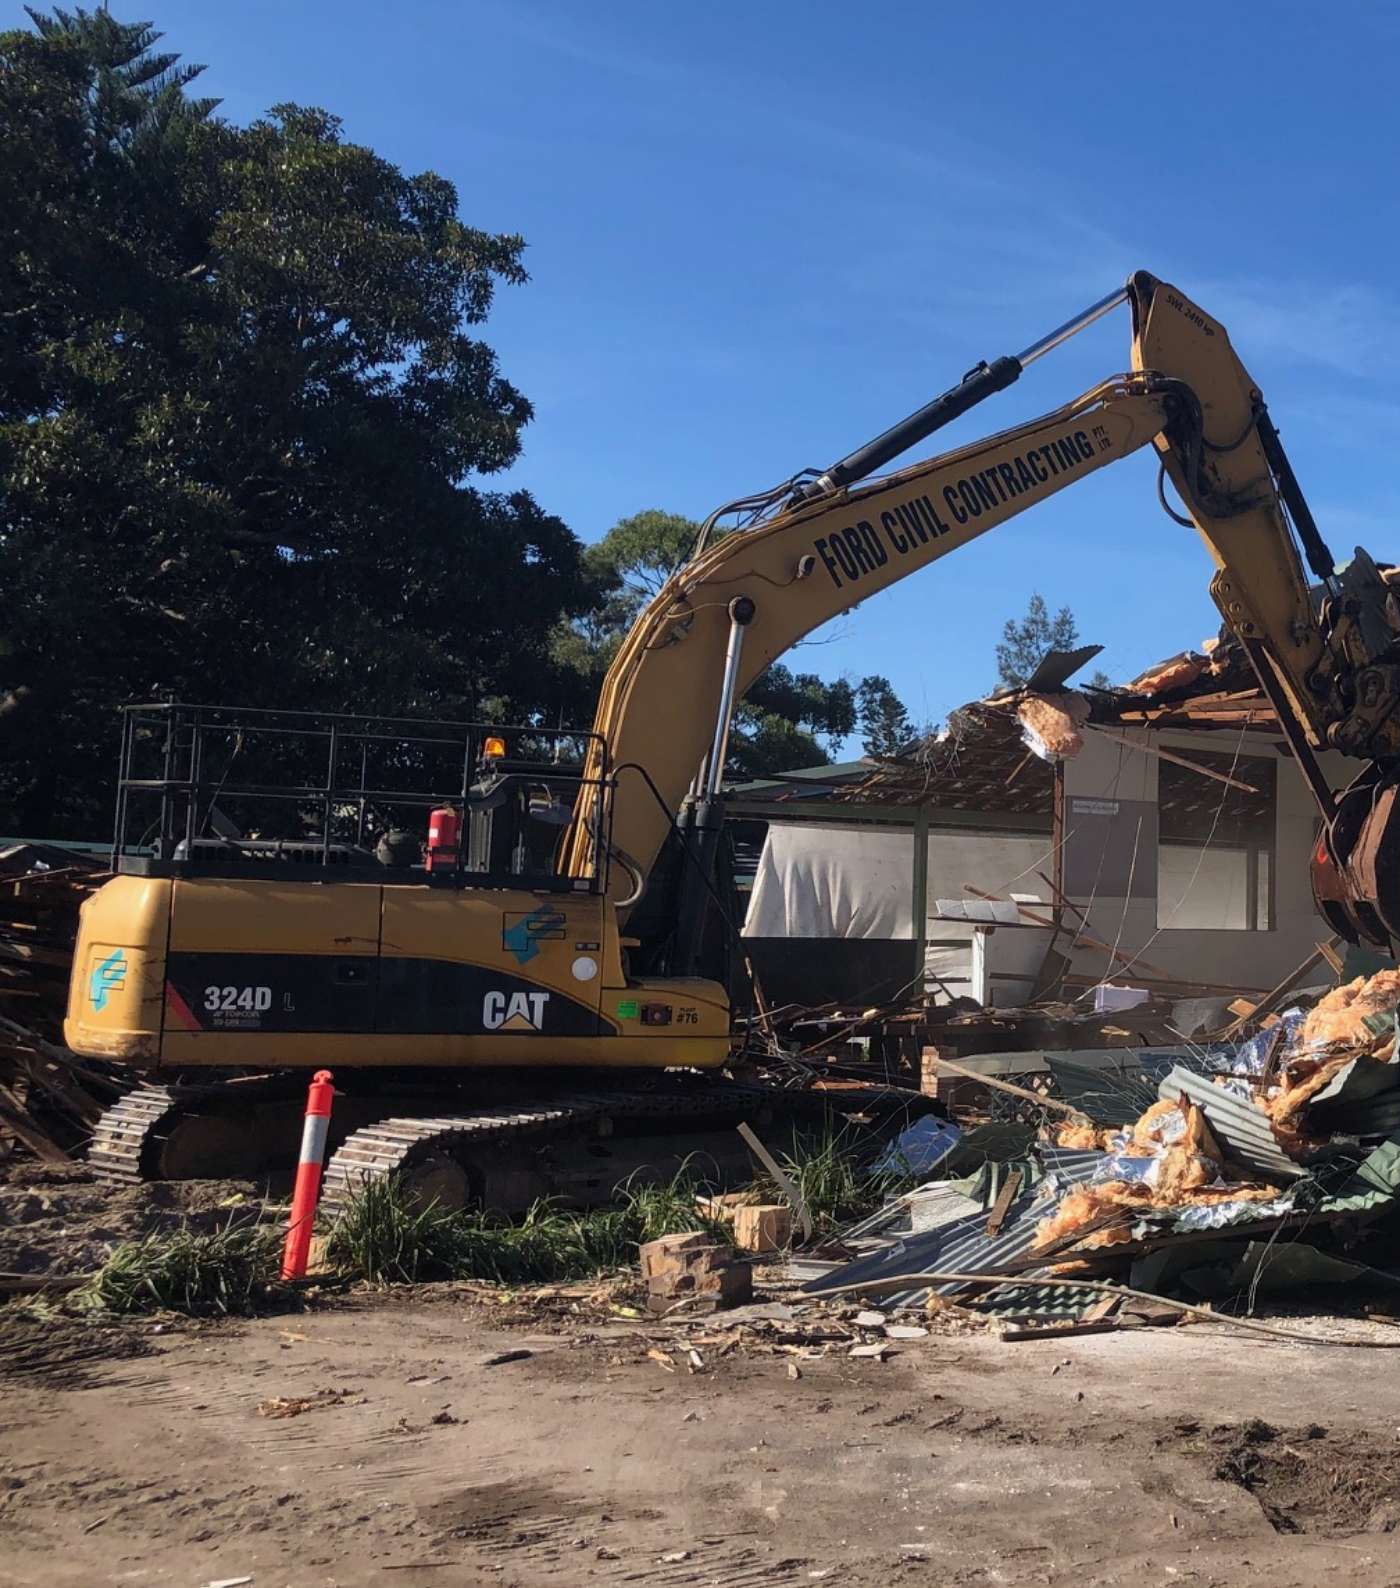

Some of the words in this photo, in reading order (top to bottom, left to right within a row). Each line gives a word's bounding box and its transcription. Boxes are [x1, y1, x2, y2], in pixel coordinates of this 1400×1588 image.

[813, 520, 889, 588] FORD
[881, 495, 950, 554] CIVIL
[942, 430, 1095, 524] CONTRACTING
[204, 986, 272, 1010] 324D
[283, 992, 295, 1011] L
[483, 991, 550, 1029] CAT
[676, 1013, 699, 1024] #76
